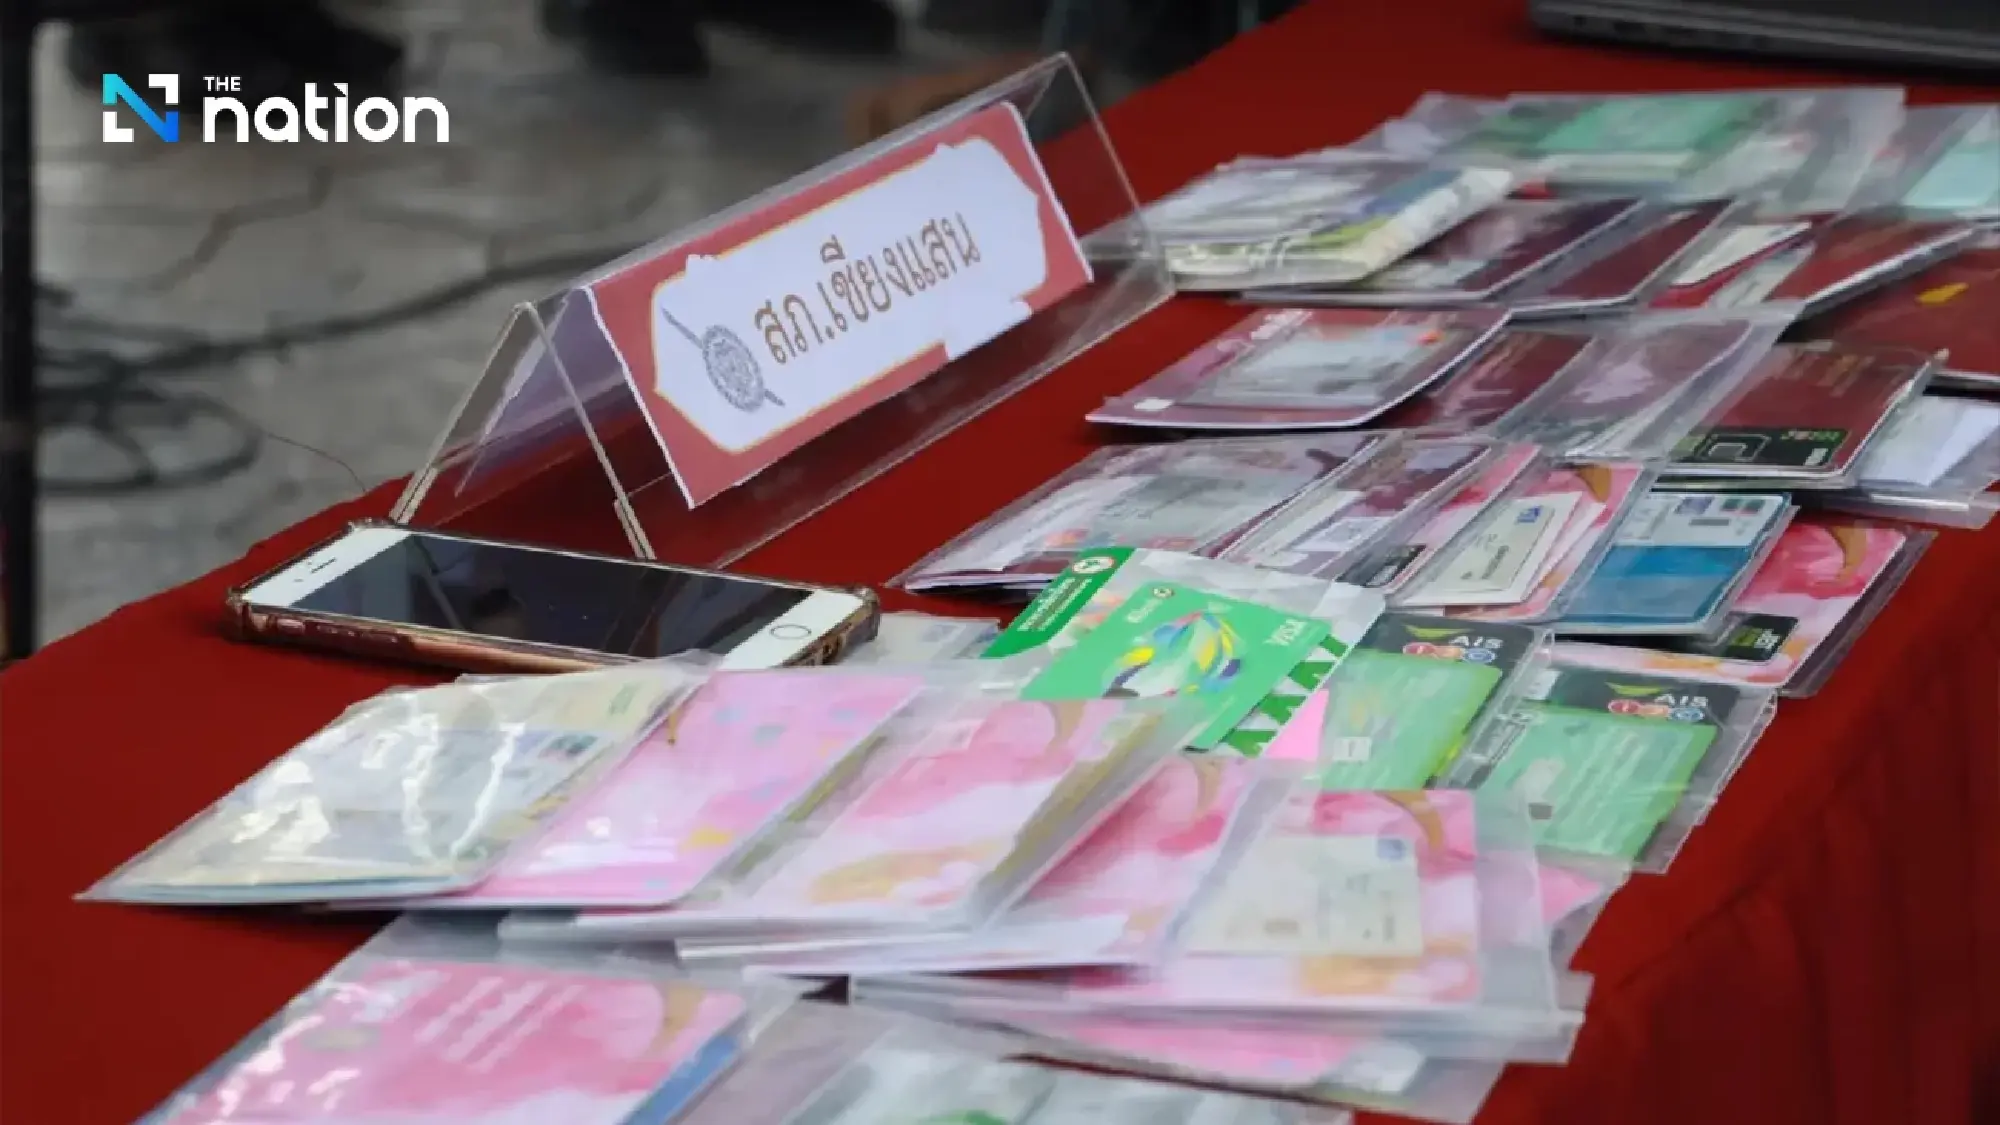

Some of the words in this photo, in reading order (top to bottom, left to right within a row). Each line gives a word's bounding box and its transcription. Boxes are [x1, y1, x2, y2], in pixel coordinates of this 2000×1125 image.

[754, 211, 981, 364] สภ.เชียงแสน
[1449, 635, 1503, 649] AIS
[1653, 693, 1708, 707] AIS
